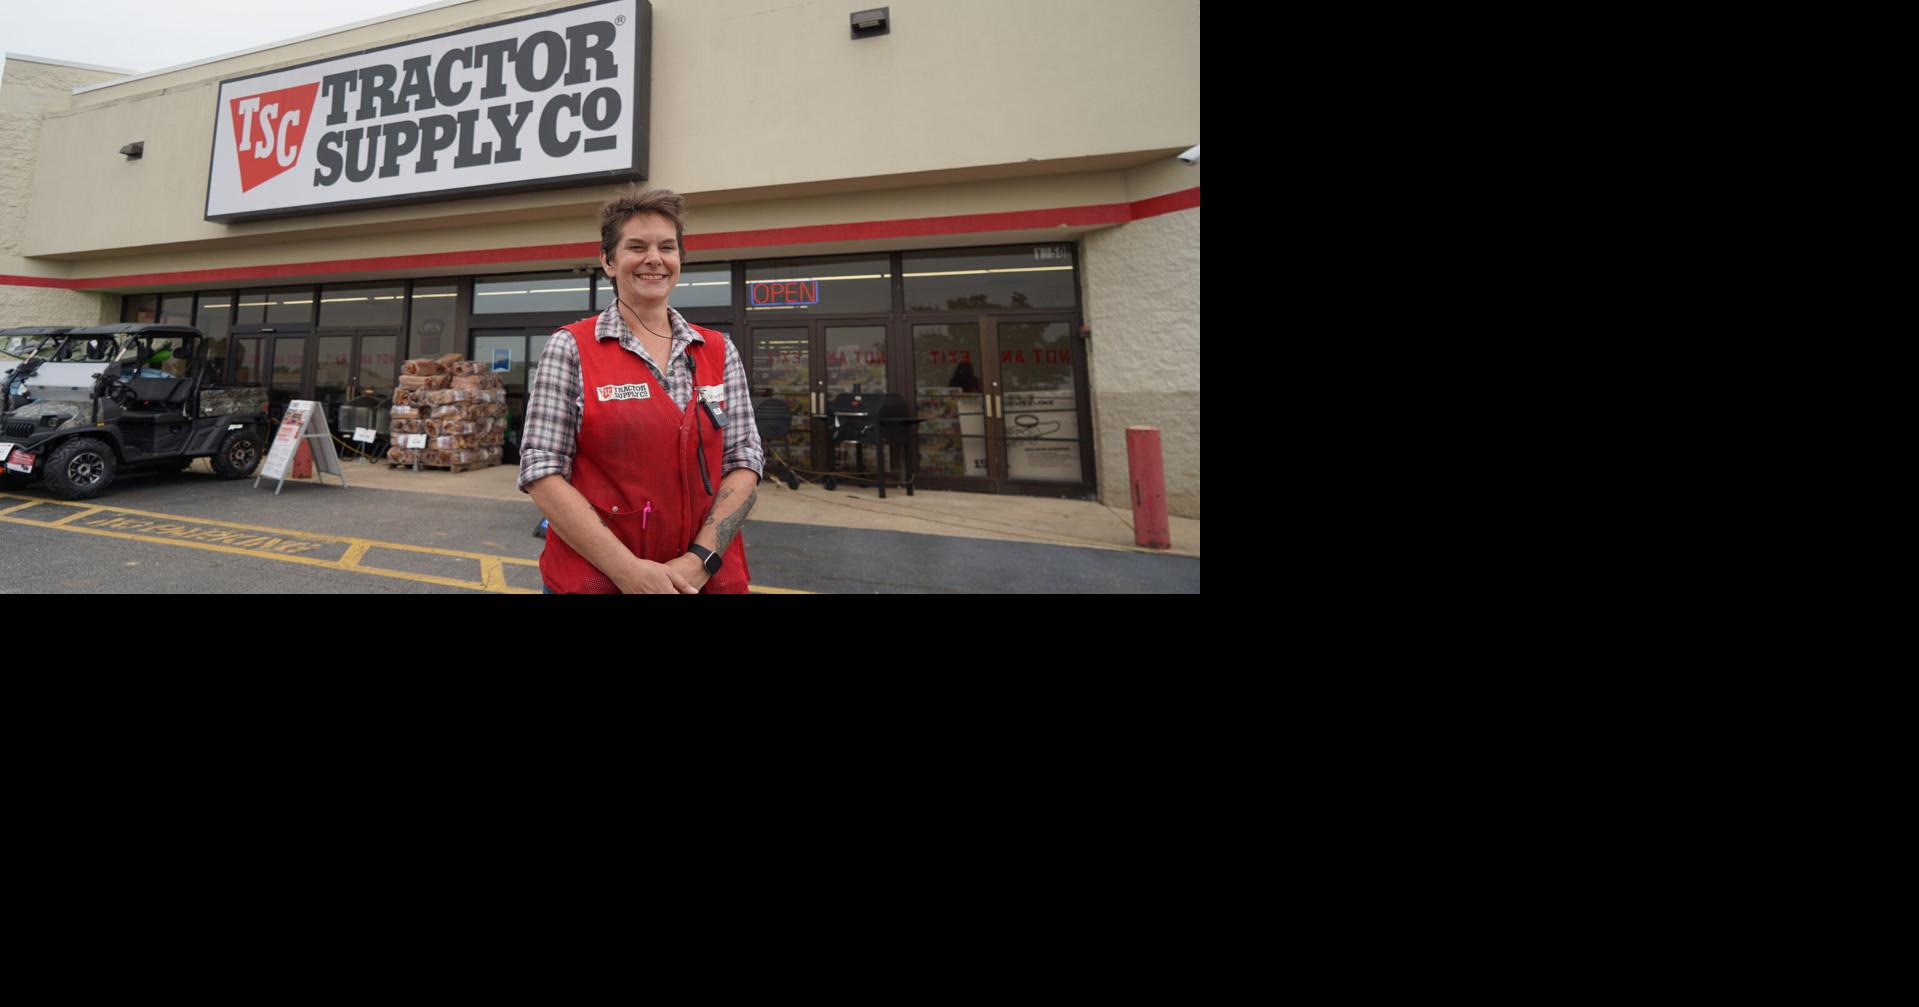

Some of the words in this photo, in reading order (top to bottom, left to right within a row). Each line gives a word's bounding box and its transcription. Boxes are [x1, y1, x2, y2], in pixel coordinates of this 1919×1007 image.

[322, 20, 619, 126] TRACTOR
[238, 97, 301, 168] TSC
[313, 99, 533, 187] SUPPLY
[754, 281, 816, 303] OPEN
[614, 385, 647, 393] TRACTOR
